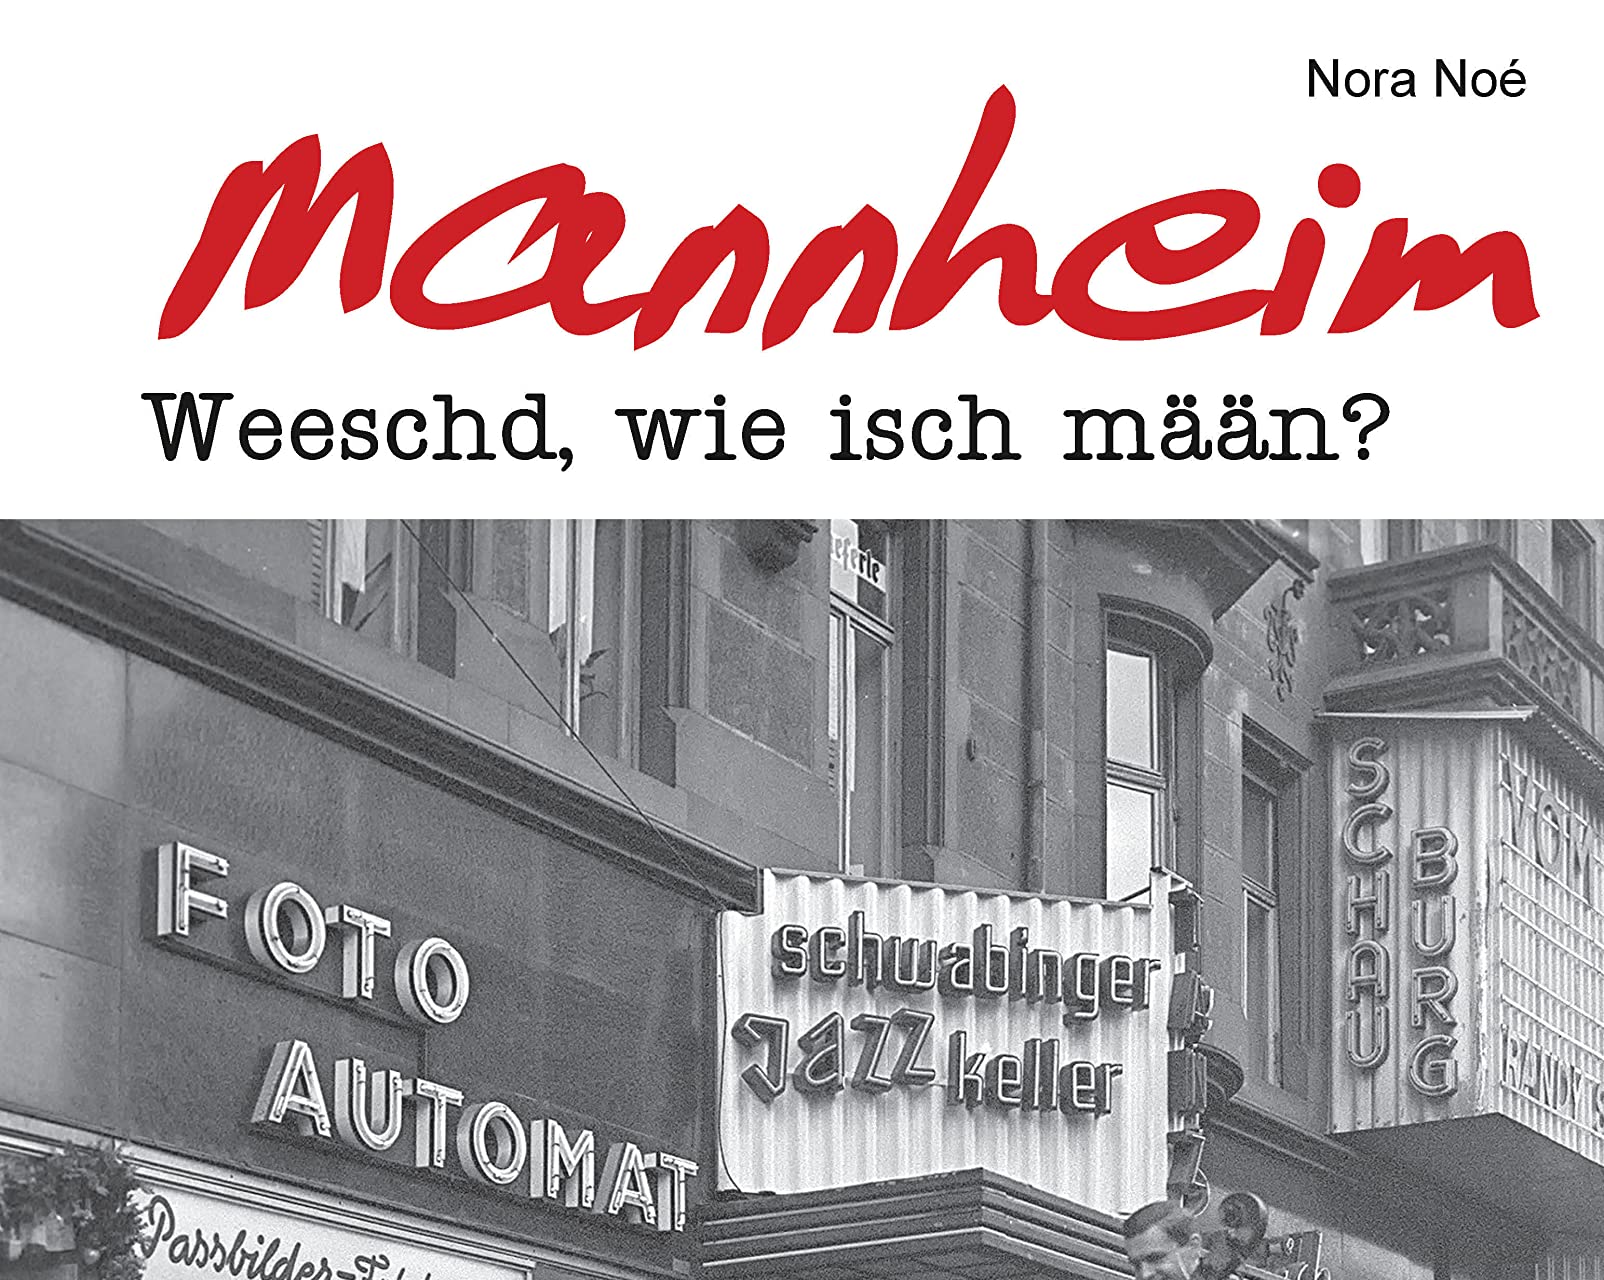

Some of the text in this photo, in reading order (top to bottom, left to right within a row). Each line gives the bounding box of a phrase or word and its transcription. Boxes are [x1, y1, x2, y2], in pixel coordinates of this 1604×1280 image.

[157, 841, 470, 1024] FOTO
[771, 910, 1161, 1021] schwabinger
[1342, 737, 1393, 1070] SCHAU
[1409, 826, 1459, 1097] BURG
[251, 1039, 699, 1232] AUTOMAT
[947, 1030, 1123, 1116] keller
